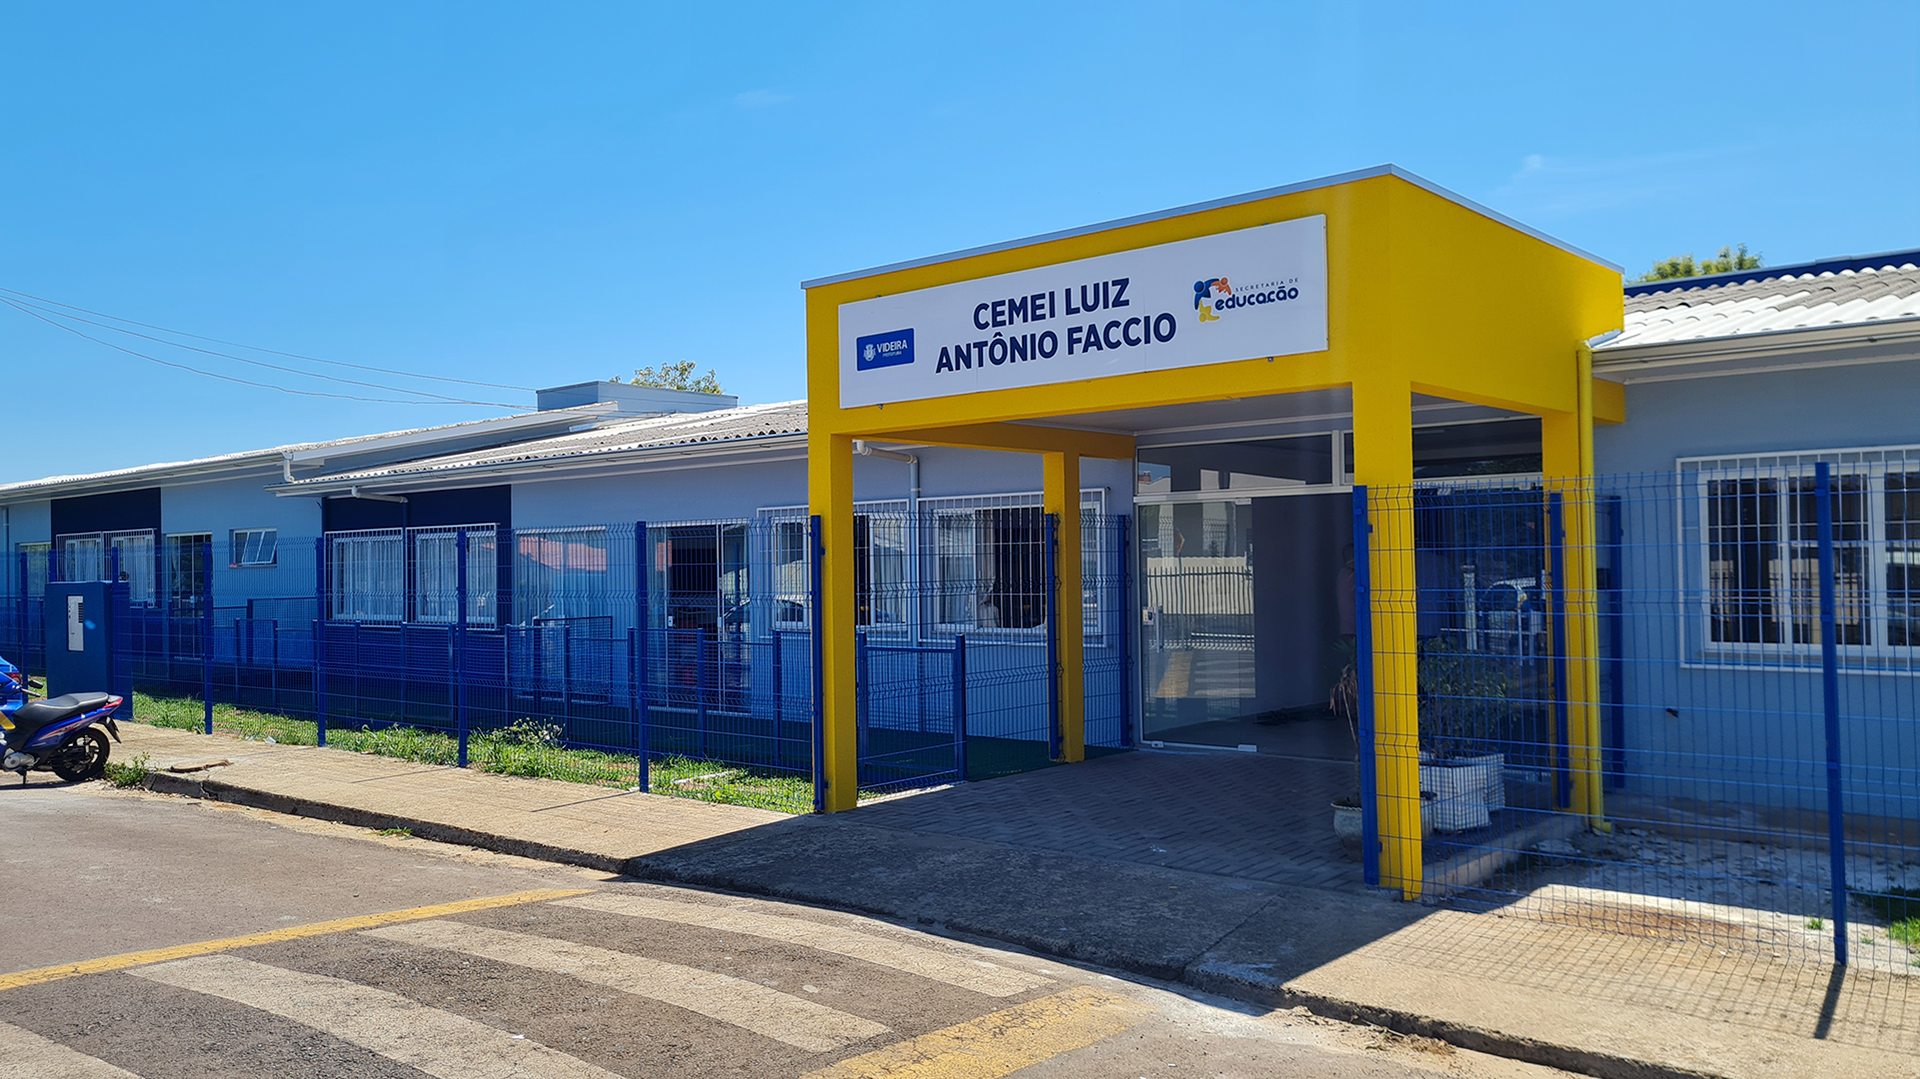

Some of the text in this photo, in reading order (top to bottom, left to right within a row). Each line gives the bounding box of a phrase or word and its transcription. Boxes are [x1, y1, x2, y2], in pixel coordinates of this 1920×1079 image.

[1215, 286, 1299, 311] educação
[1235, 280, 1284, 292] SECRETARIA
[973, 278, 1130, 330] CEMEI LUIZ
[876, 339, 908, 353] VIDEIRA
[935, 312, 1177, 374] ANTÔNIO FACCIO
